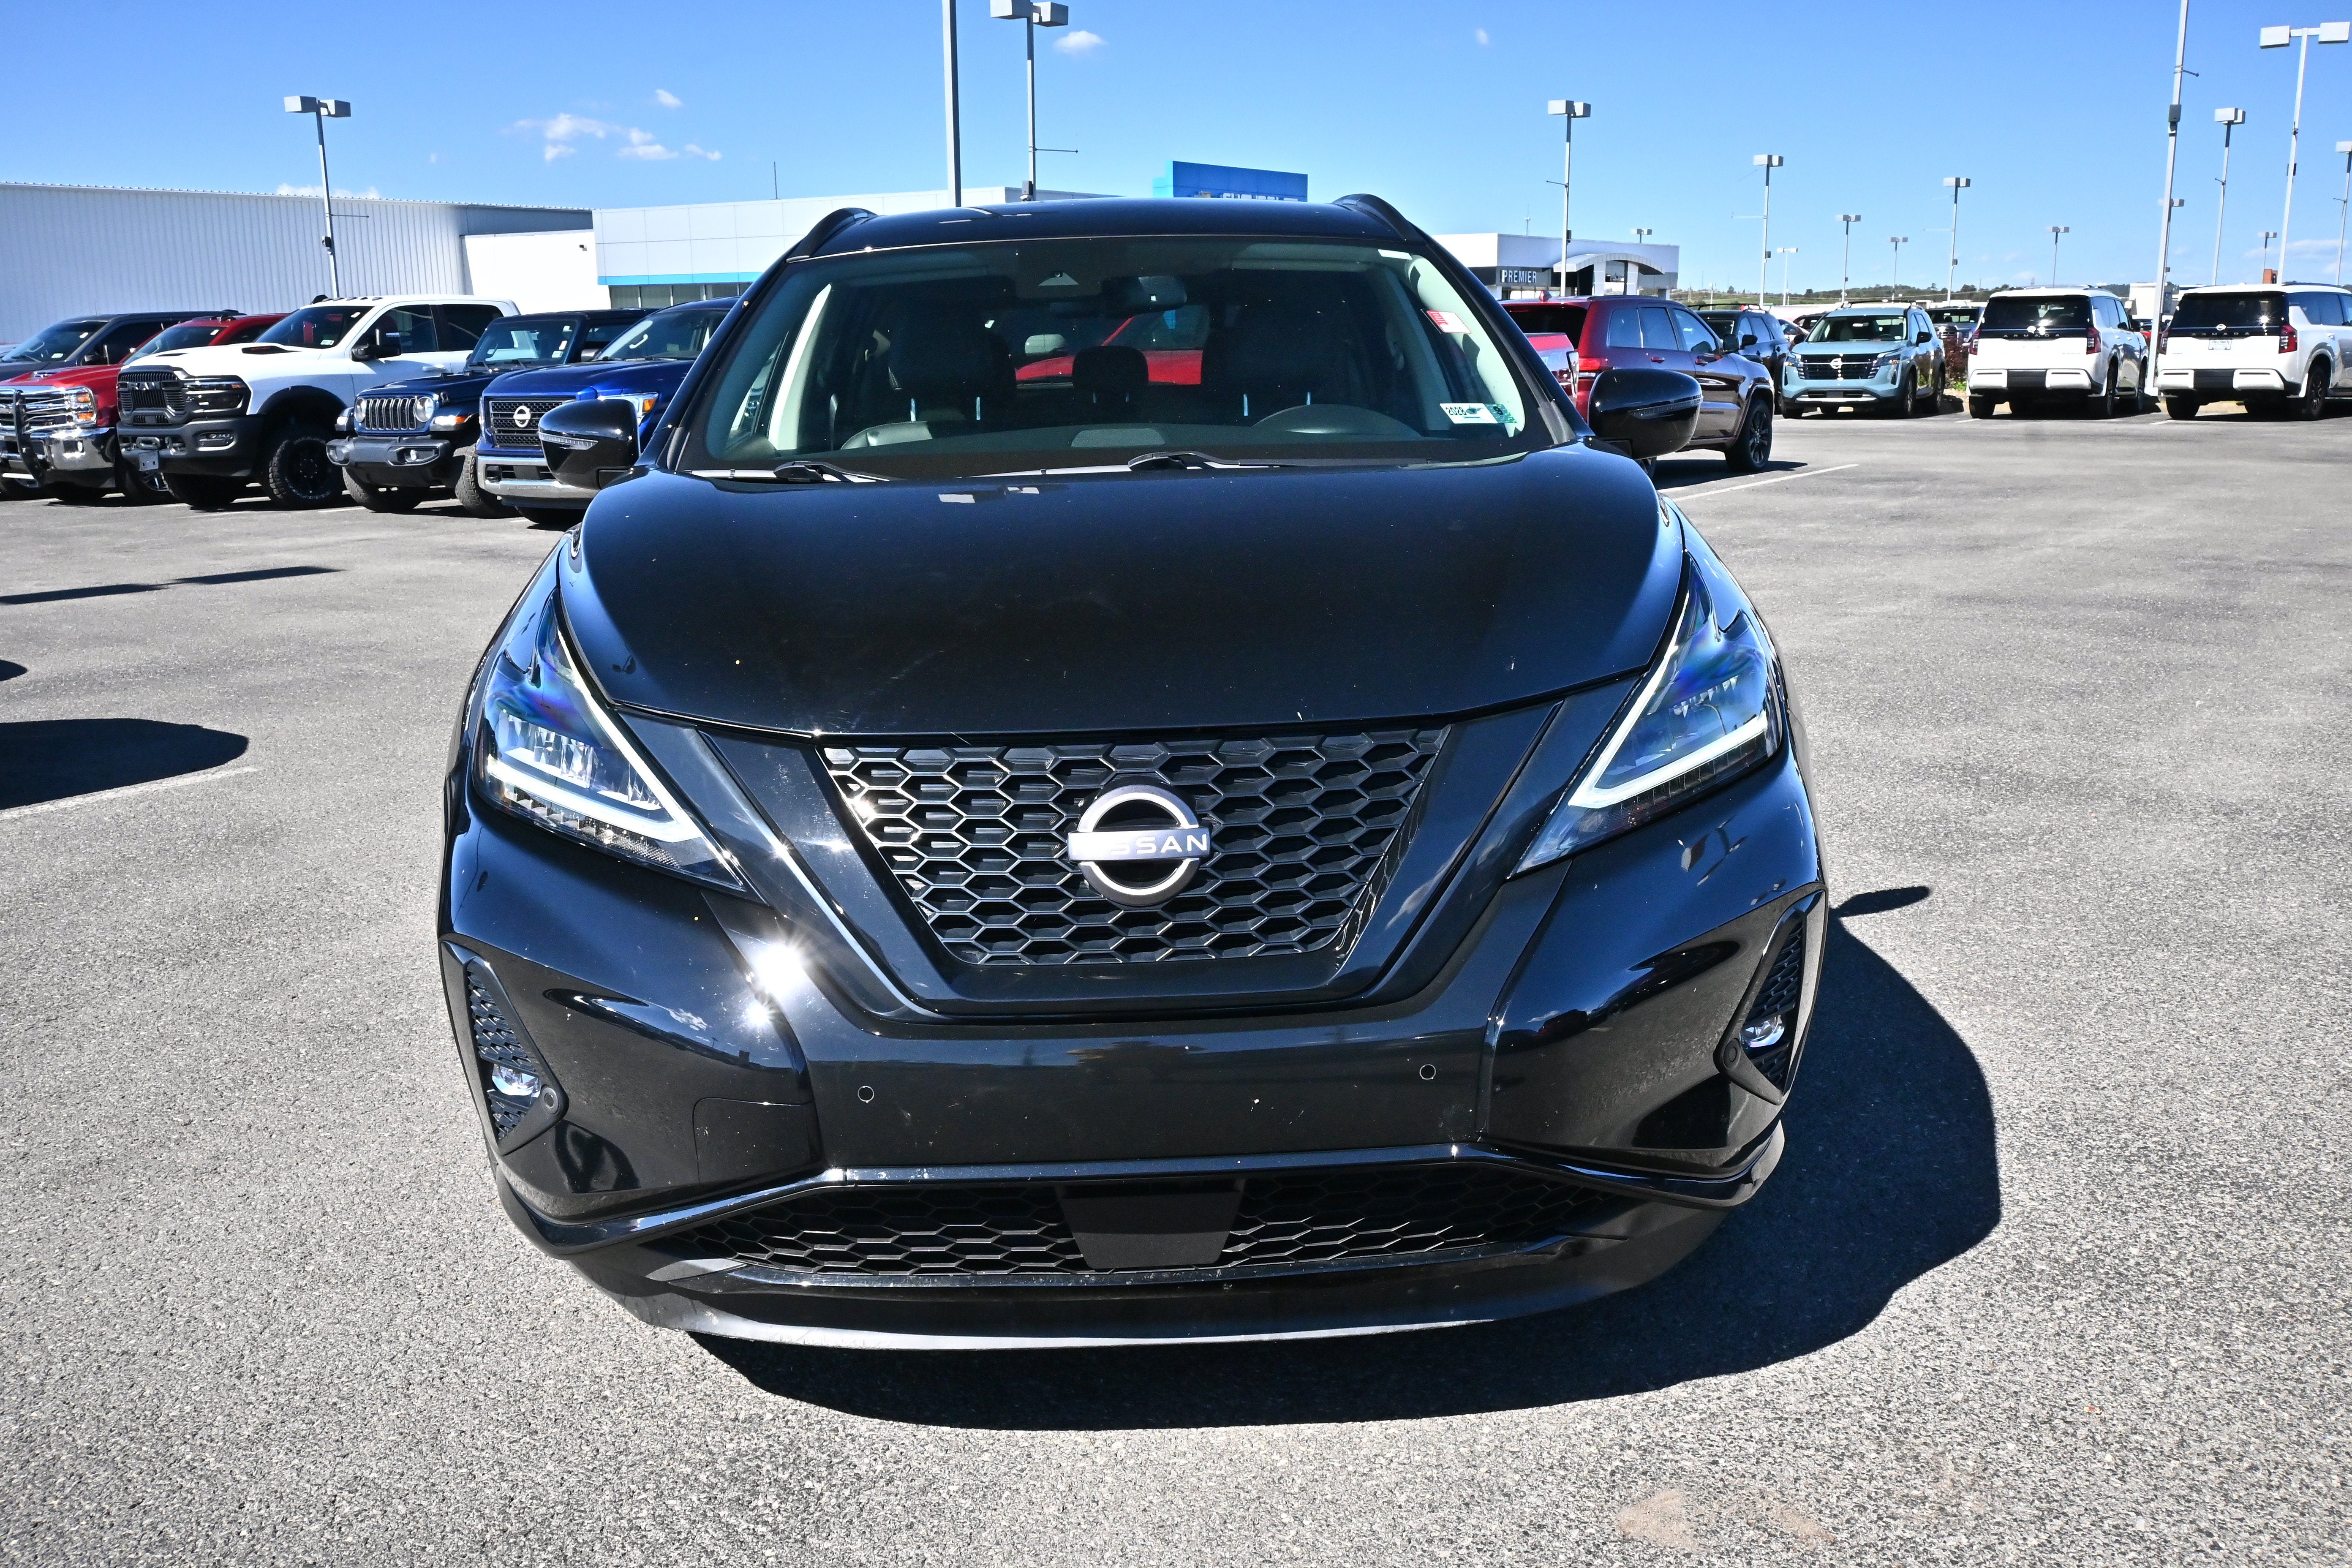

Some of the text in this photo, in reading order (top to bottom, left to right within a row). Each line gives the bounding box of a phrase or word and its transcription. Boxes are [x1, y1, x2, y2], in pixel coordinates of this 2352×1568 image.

[1502, 270, 1537, 283] PREMIER
[1446, 407, 1467, 415] 2028
[1493, 406, 1503, 415] 9
[1072, 834, 1207, 856] SSAN
